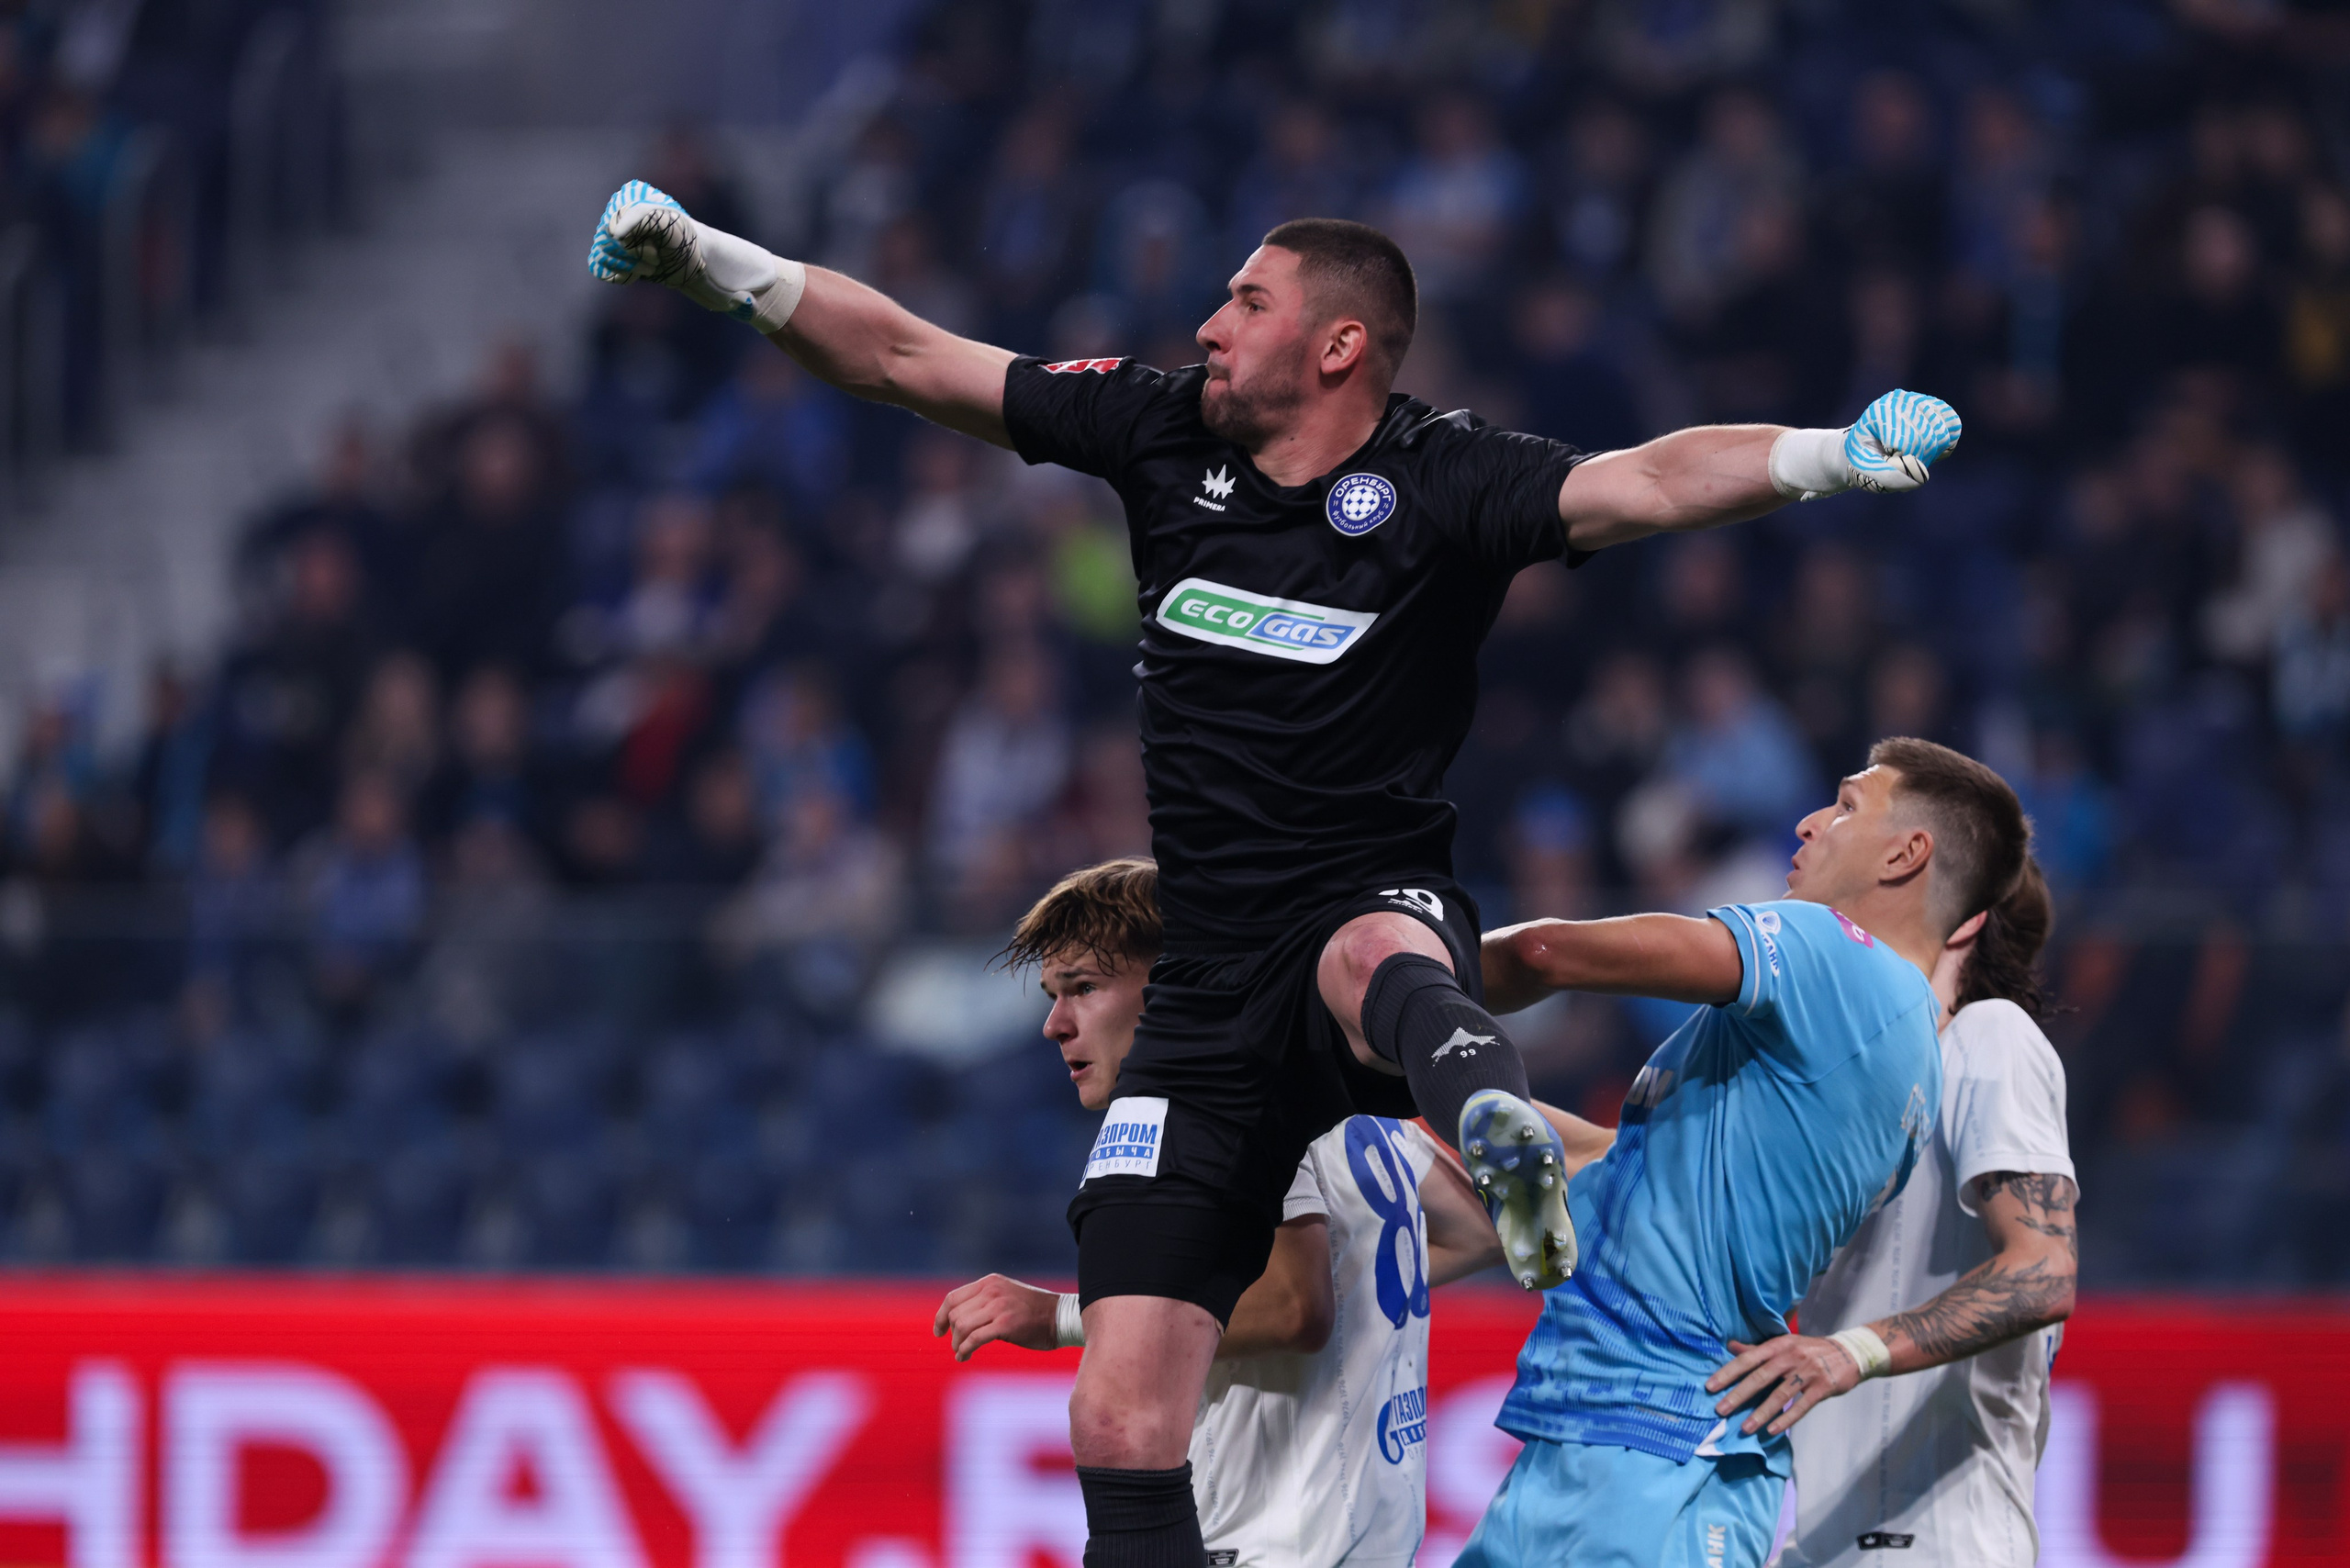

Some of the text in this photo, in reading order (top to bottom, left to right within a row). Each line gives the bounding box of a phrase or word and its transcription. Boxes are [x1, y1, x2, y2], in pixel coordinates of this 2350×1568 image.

[1335, 476, 1392, 502] ОРЕНБУРГ
[1193, 496, 1226, 512] PRIMERA
[1378, 888, 1444, 922] 9
[1460, 1048, 1477, 1058] 99
[1093, 1123, 1158, 1148] АЗПРОМ
[1091, 1146, 1151, 1159] ОБЫЧА
[1089, 1159, 1152, 1172] РЕНБУРГ
